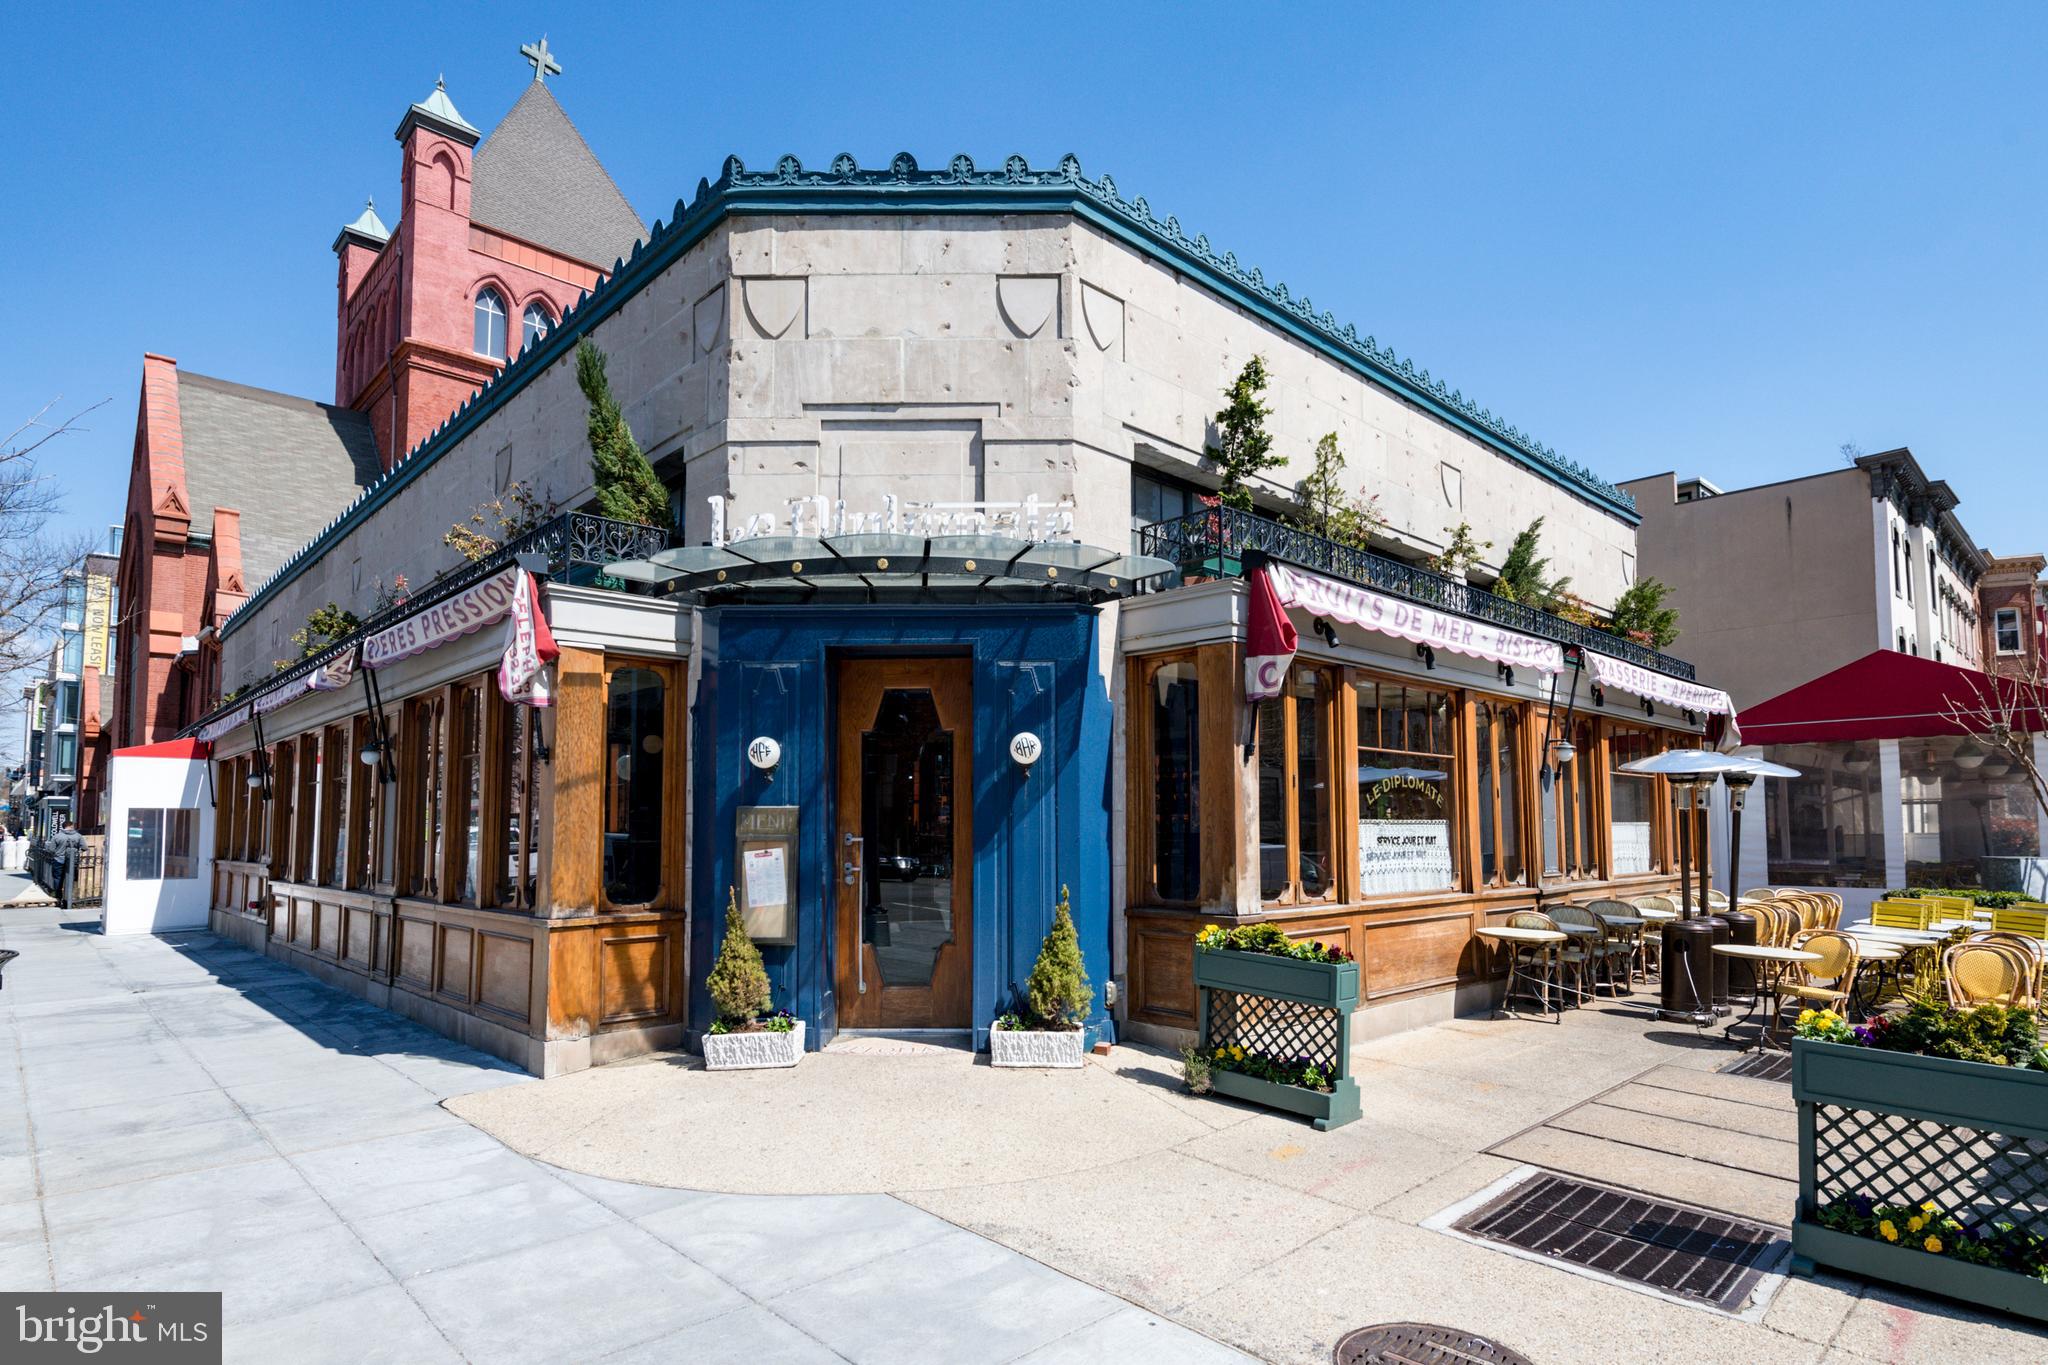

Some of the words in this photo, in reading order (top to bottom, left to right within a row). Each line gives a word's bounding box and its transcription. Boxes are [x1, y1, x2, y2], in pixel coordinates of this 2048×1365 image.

[92, 608, 105, 634] NOW
[1394, 603, 1424, 633] DE
[1432, 613, 1473, 645] MER
[1496, 629, 1556, 662] BISTRO
[1598, 659, 1657, 692] RASSERIE
[1015, 737, 1037, 757] BAR
[1366, 784, 1381, 806] LE
[1382, 775, 1444, 809] DIPLOMATE
[740, 812, 793, 832] MENU
